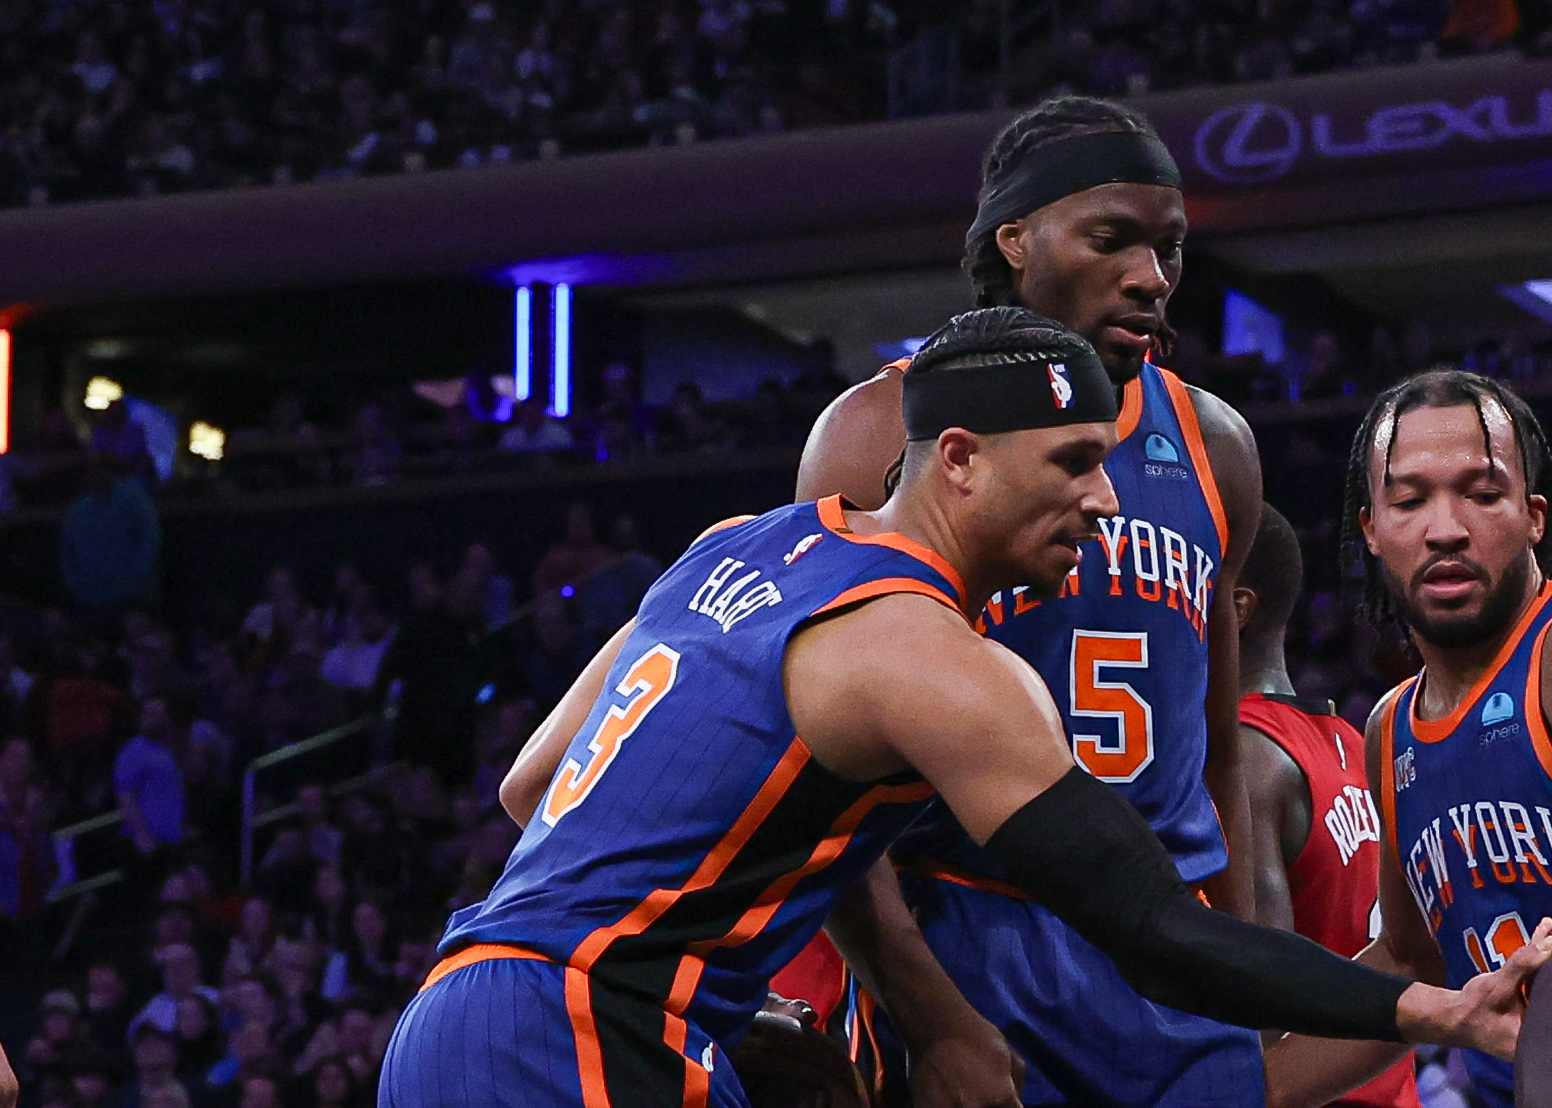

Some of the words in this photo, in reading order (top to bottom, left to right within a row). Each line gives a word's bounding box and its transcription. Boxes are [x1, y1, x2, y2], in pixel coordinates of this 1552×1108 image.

[1096, 515, 1214, 628] YORK
[541, 642, 682, 829] 3
[1068, 628, 1155, 785] 5
